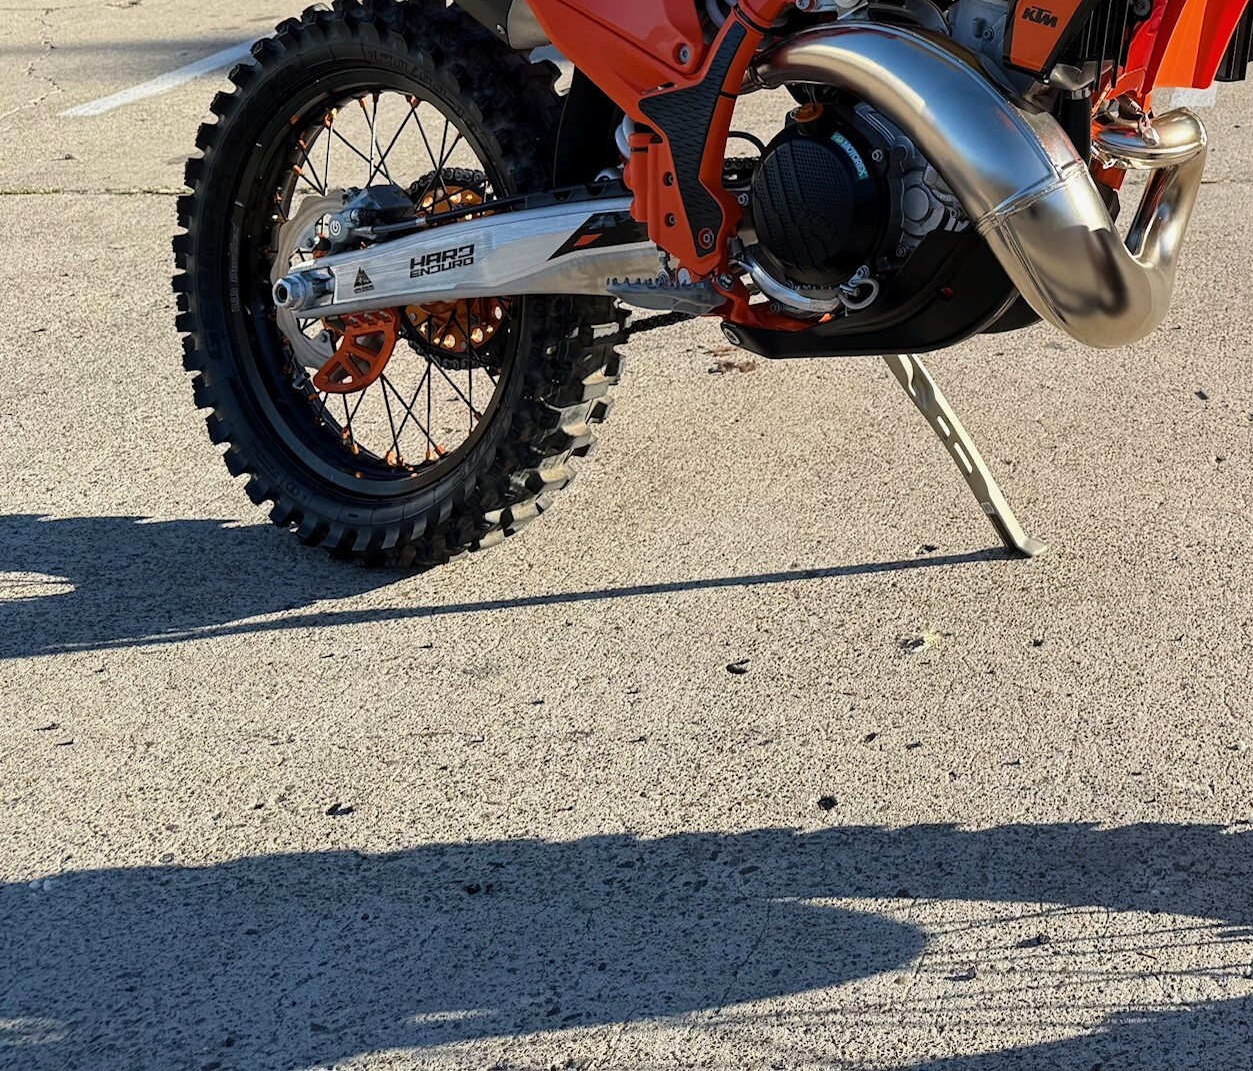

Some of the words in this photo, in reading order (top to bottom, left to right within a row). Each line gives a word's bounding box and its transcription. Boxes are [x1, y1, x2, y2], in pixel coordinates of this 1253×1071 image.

[1022, 6, 1058, 28] KTM
[842, 140, 868, 178] MOTOREX
[410, 244, 475, 270] HARD
[410, 257, 474, 278] ENDURO
